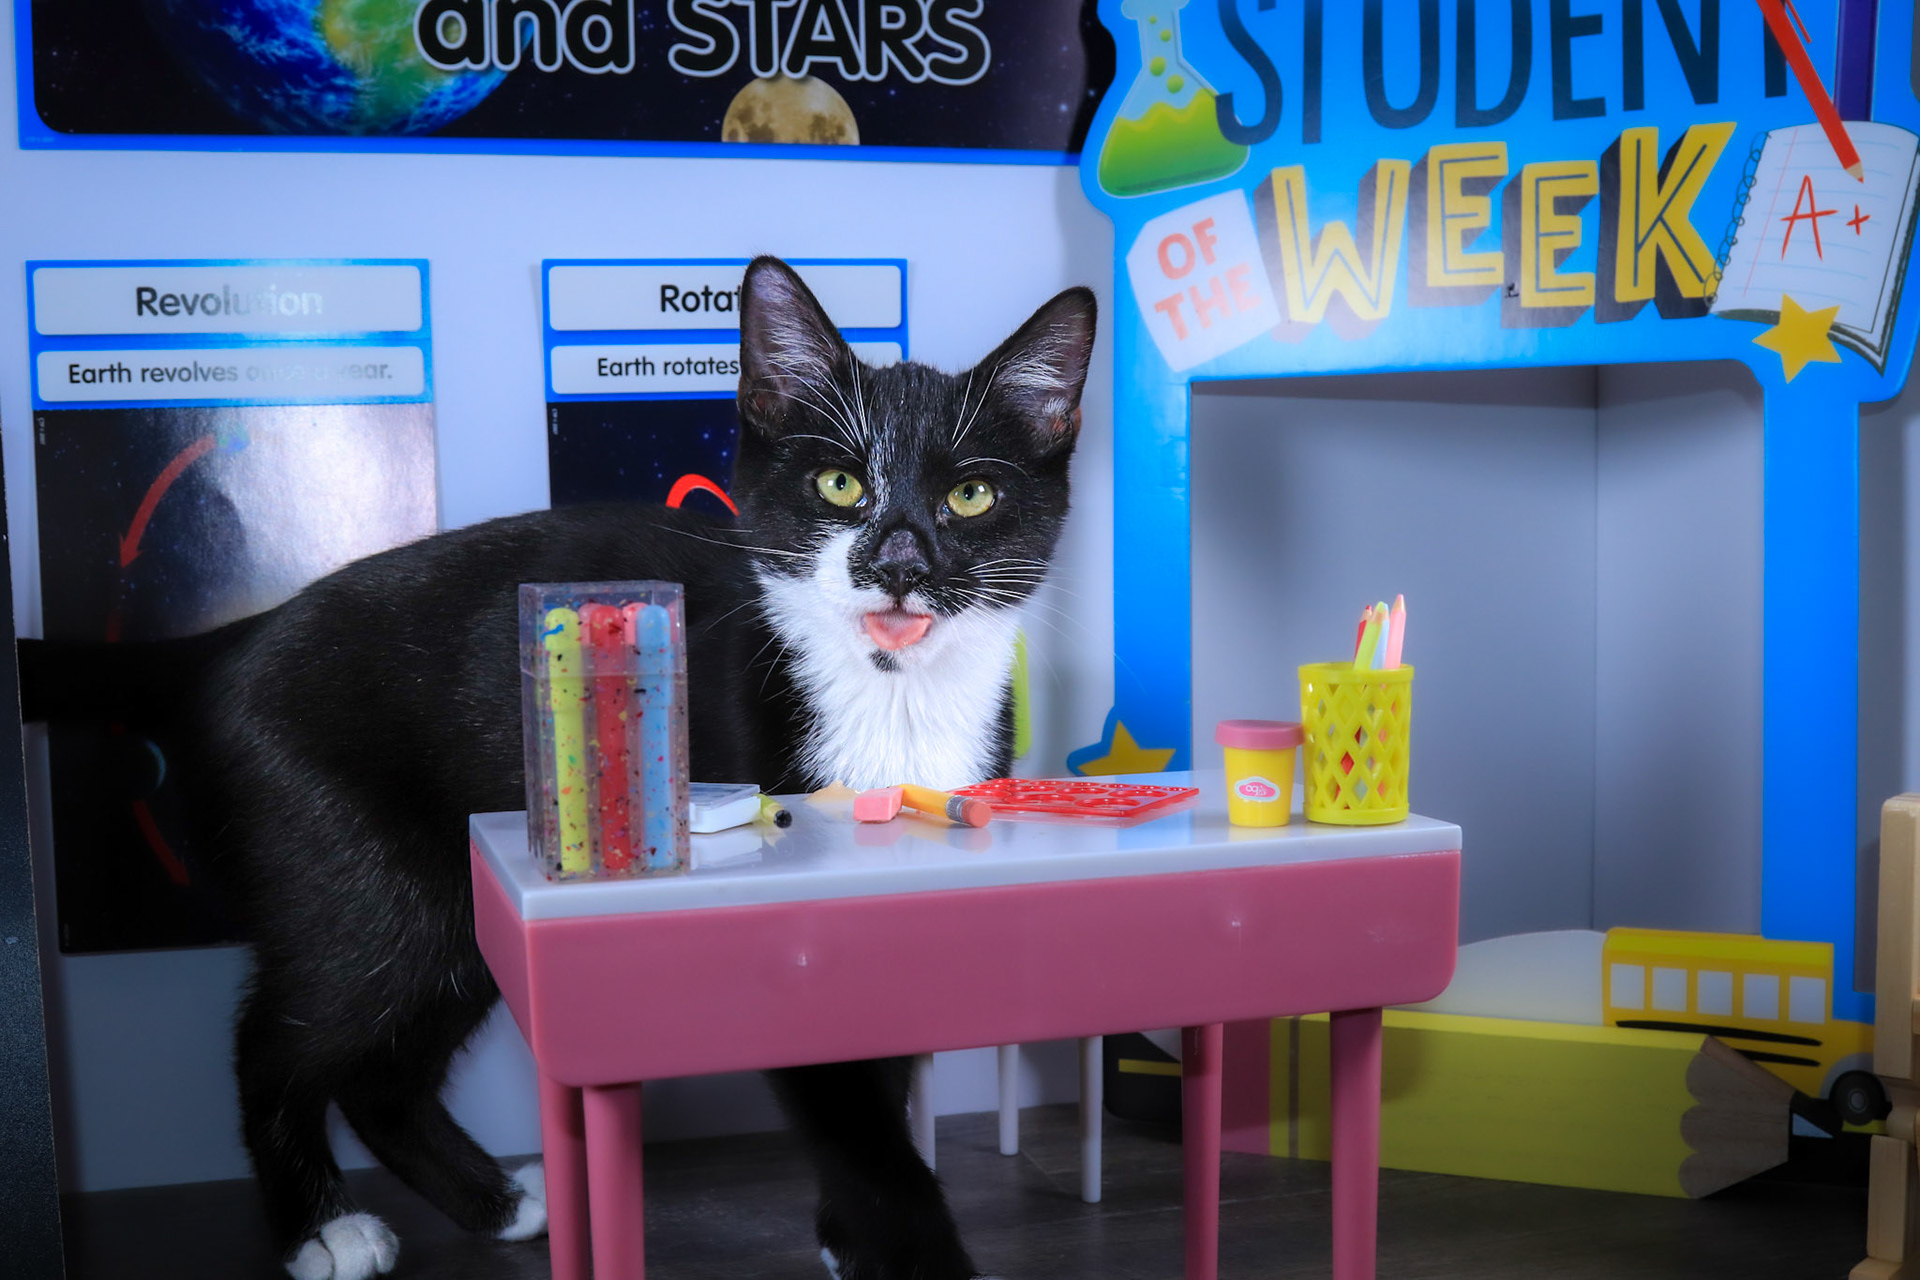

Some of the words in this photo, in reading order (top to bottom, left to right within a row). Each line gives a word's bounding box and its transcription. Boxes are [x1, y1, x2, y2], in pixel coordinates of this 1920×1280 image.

[414, 0, 635, 74] and
[668, 0, 991, 85] STARS
[1157, 217, 1218, 280] OF
[1258, 121, 1737, 332] WEEK
[1779, 174, 1871, 262] A+
[136, 284, 323, 317] Revoluion
[1153, 262, 1262, 342] THE
[69, 362, 132, 384] Earth
[141, 360, 239, 383] revolves
[597, 355, 655, 376] Earth
[663, 356, 740, 375] rotates
